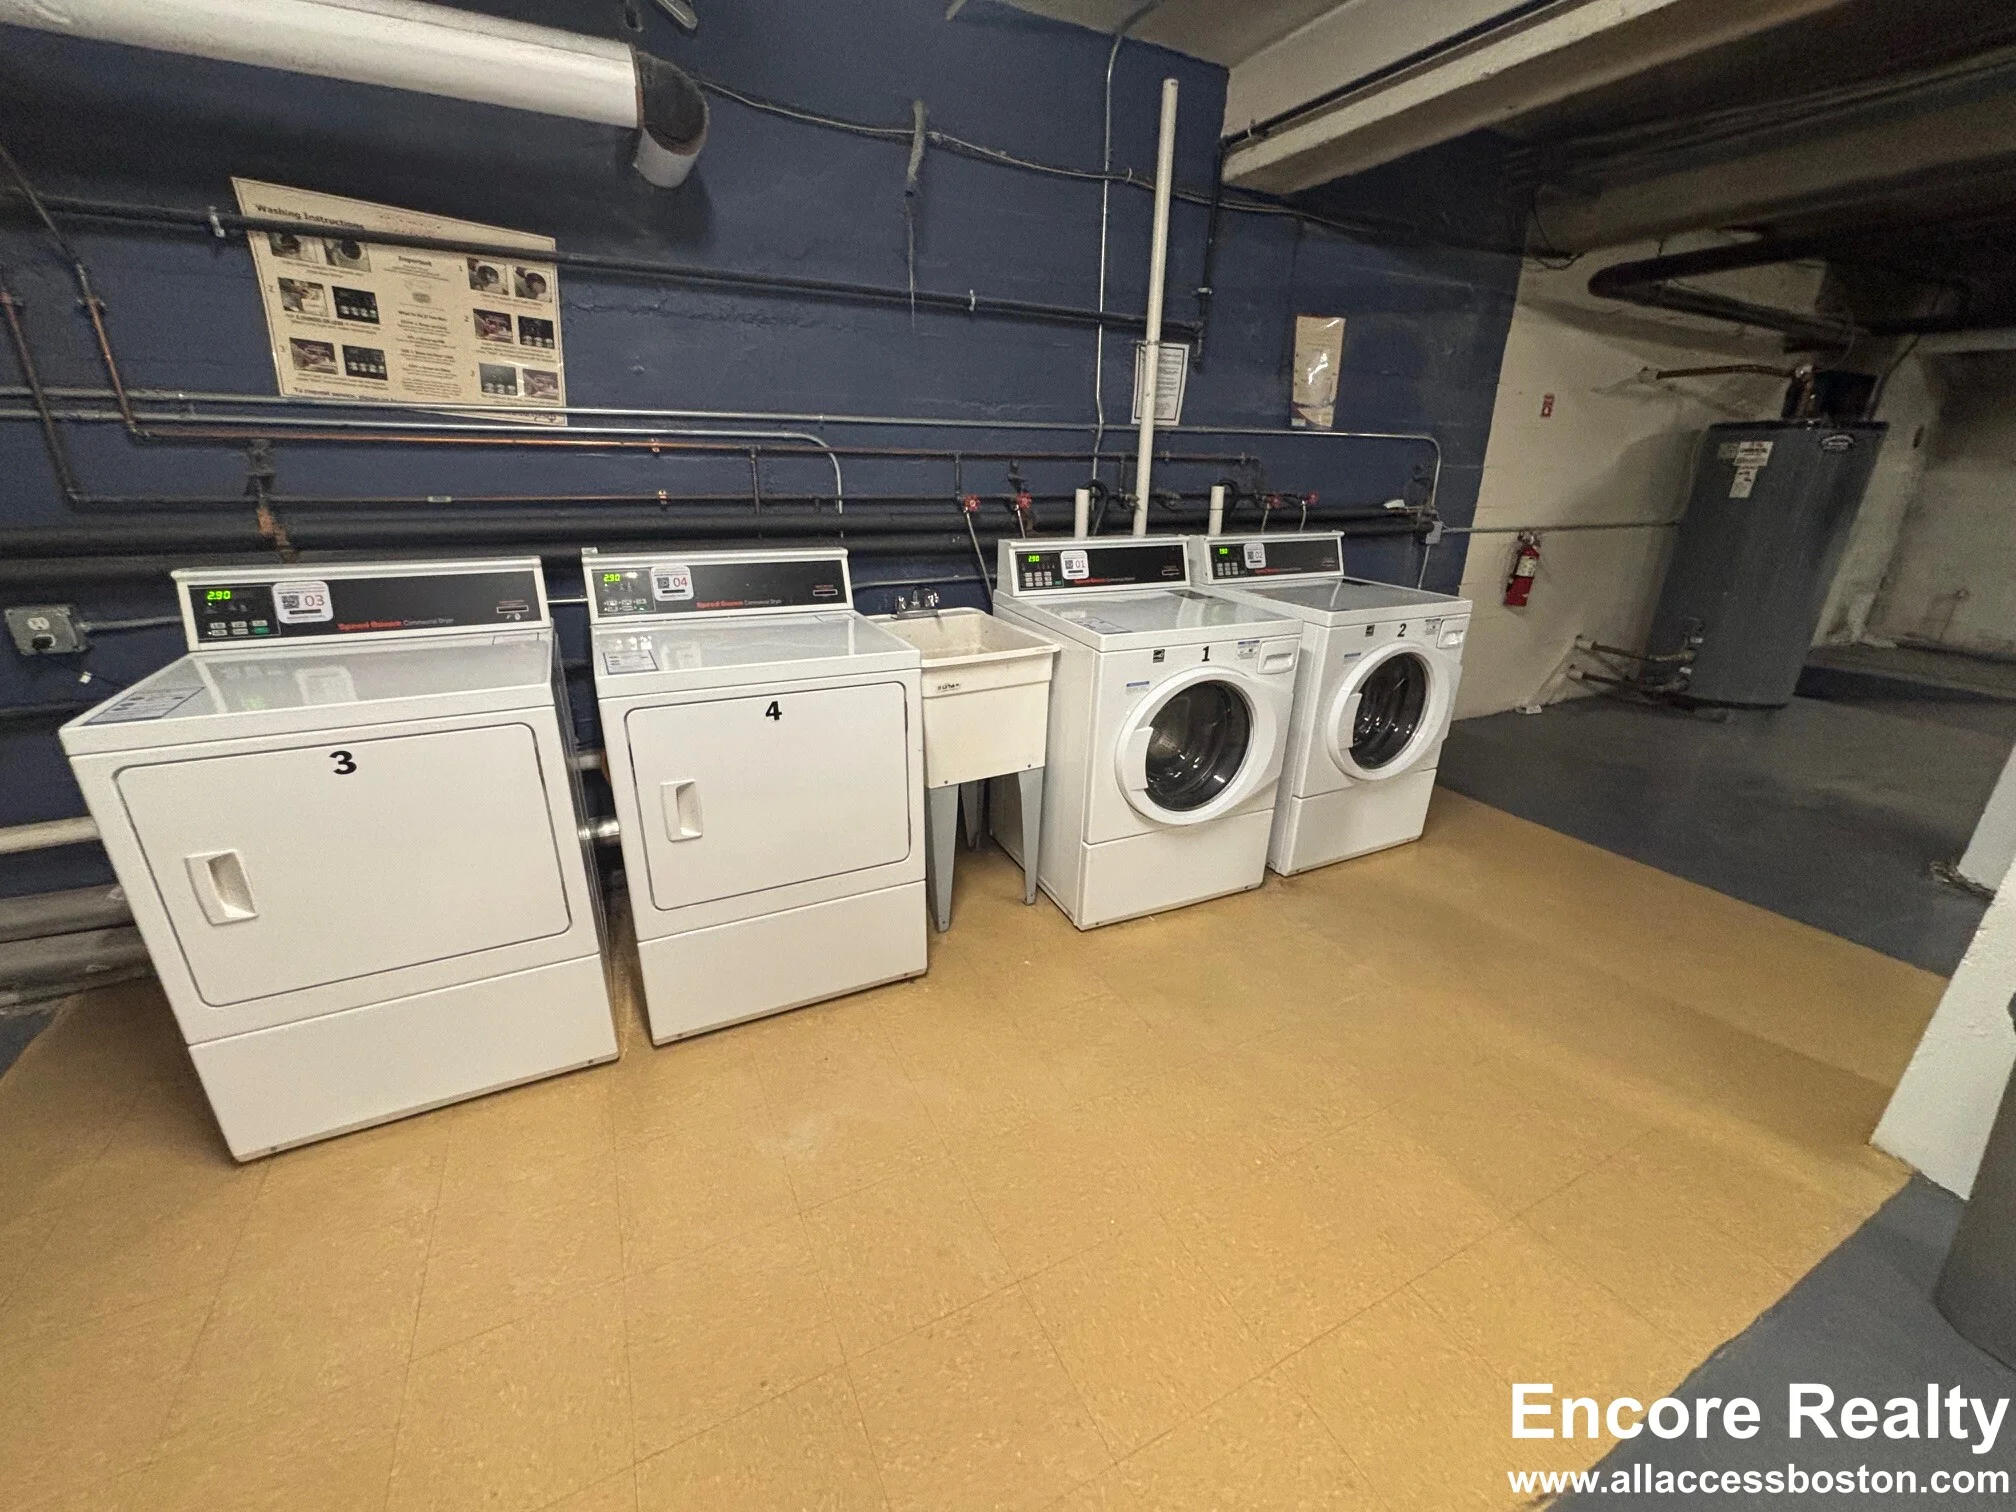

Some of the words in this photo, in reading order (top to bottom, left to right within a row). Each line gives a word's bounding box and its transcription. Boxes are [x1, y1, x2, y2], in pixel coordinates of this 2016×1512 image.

[255, 203, 301, 219] Washing
[1075, 560, 1085, 569] 01
[673, 577, 688, 587] 04
[207, 590, 231, 600] 2.90
[304, 594, 325, 607] 03
[1397, 623, 1407, 637] 2
[1201, 646, 1210, 662] 1
[765, 700, 782, 721] 4
[329, 750, 357, 775] 3
